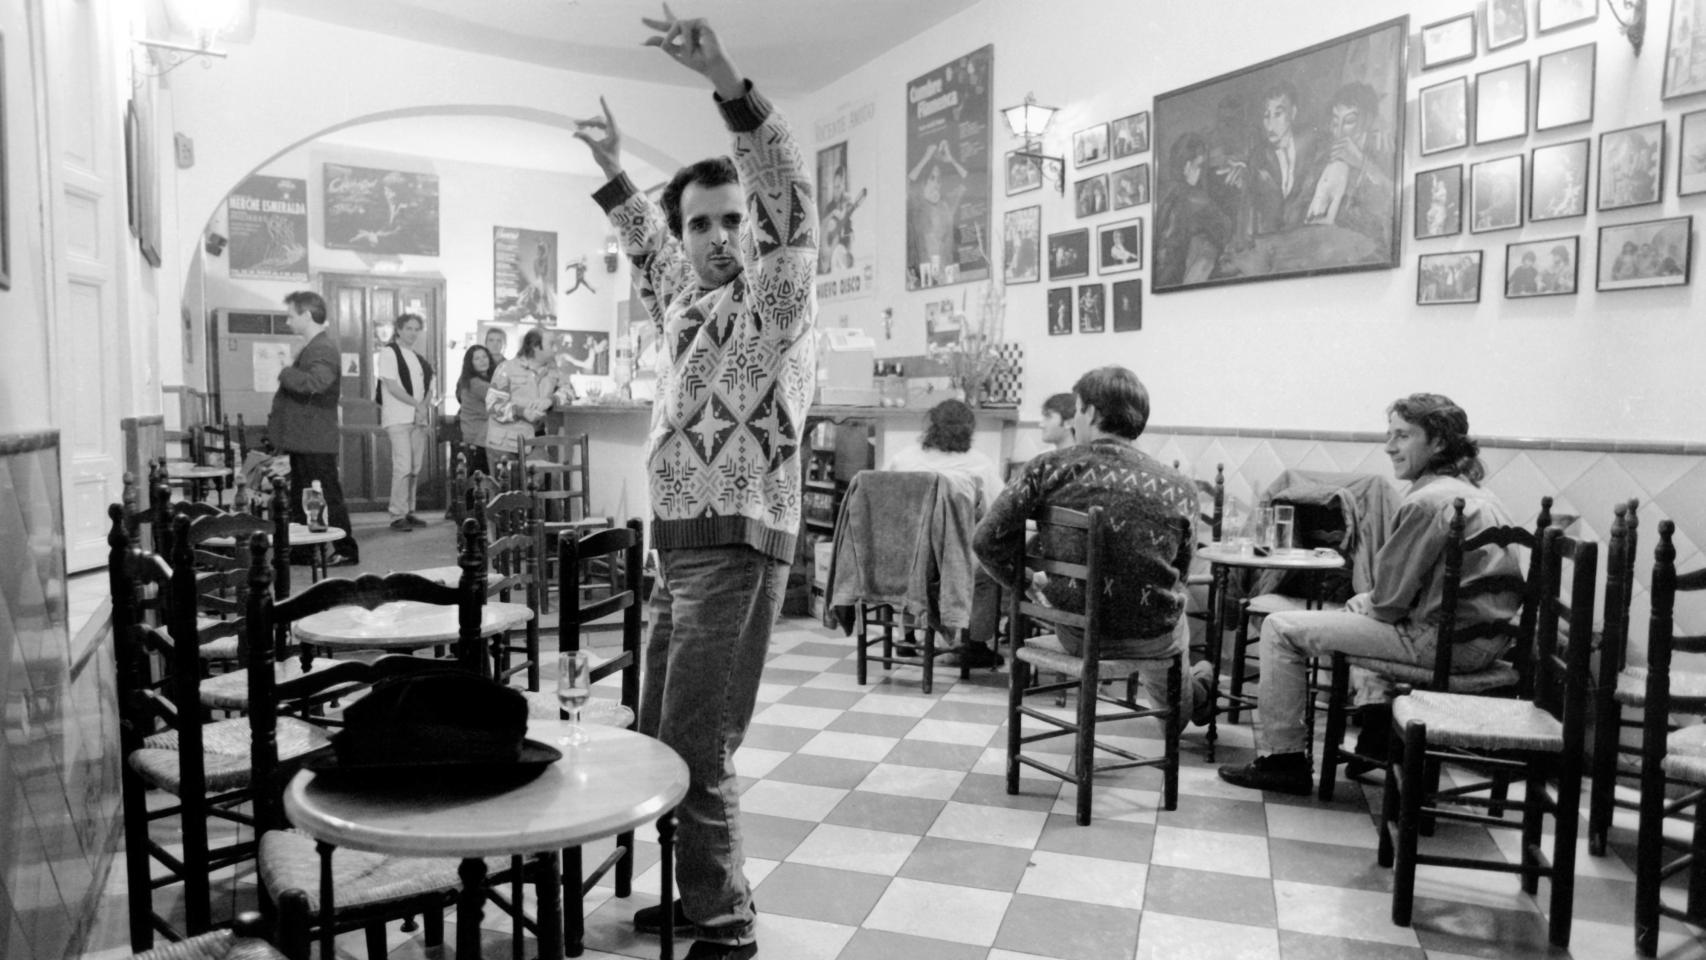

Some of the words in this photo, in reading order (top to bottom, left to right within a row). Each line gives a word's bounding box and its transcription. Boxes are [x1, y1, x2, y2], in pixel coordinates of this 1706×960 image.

[229, 197, 260, 211] MERCHE
[262, 200, 305, 215] ESMERALDA
[840, 275, 860, 295] DISCO
